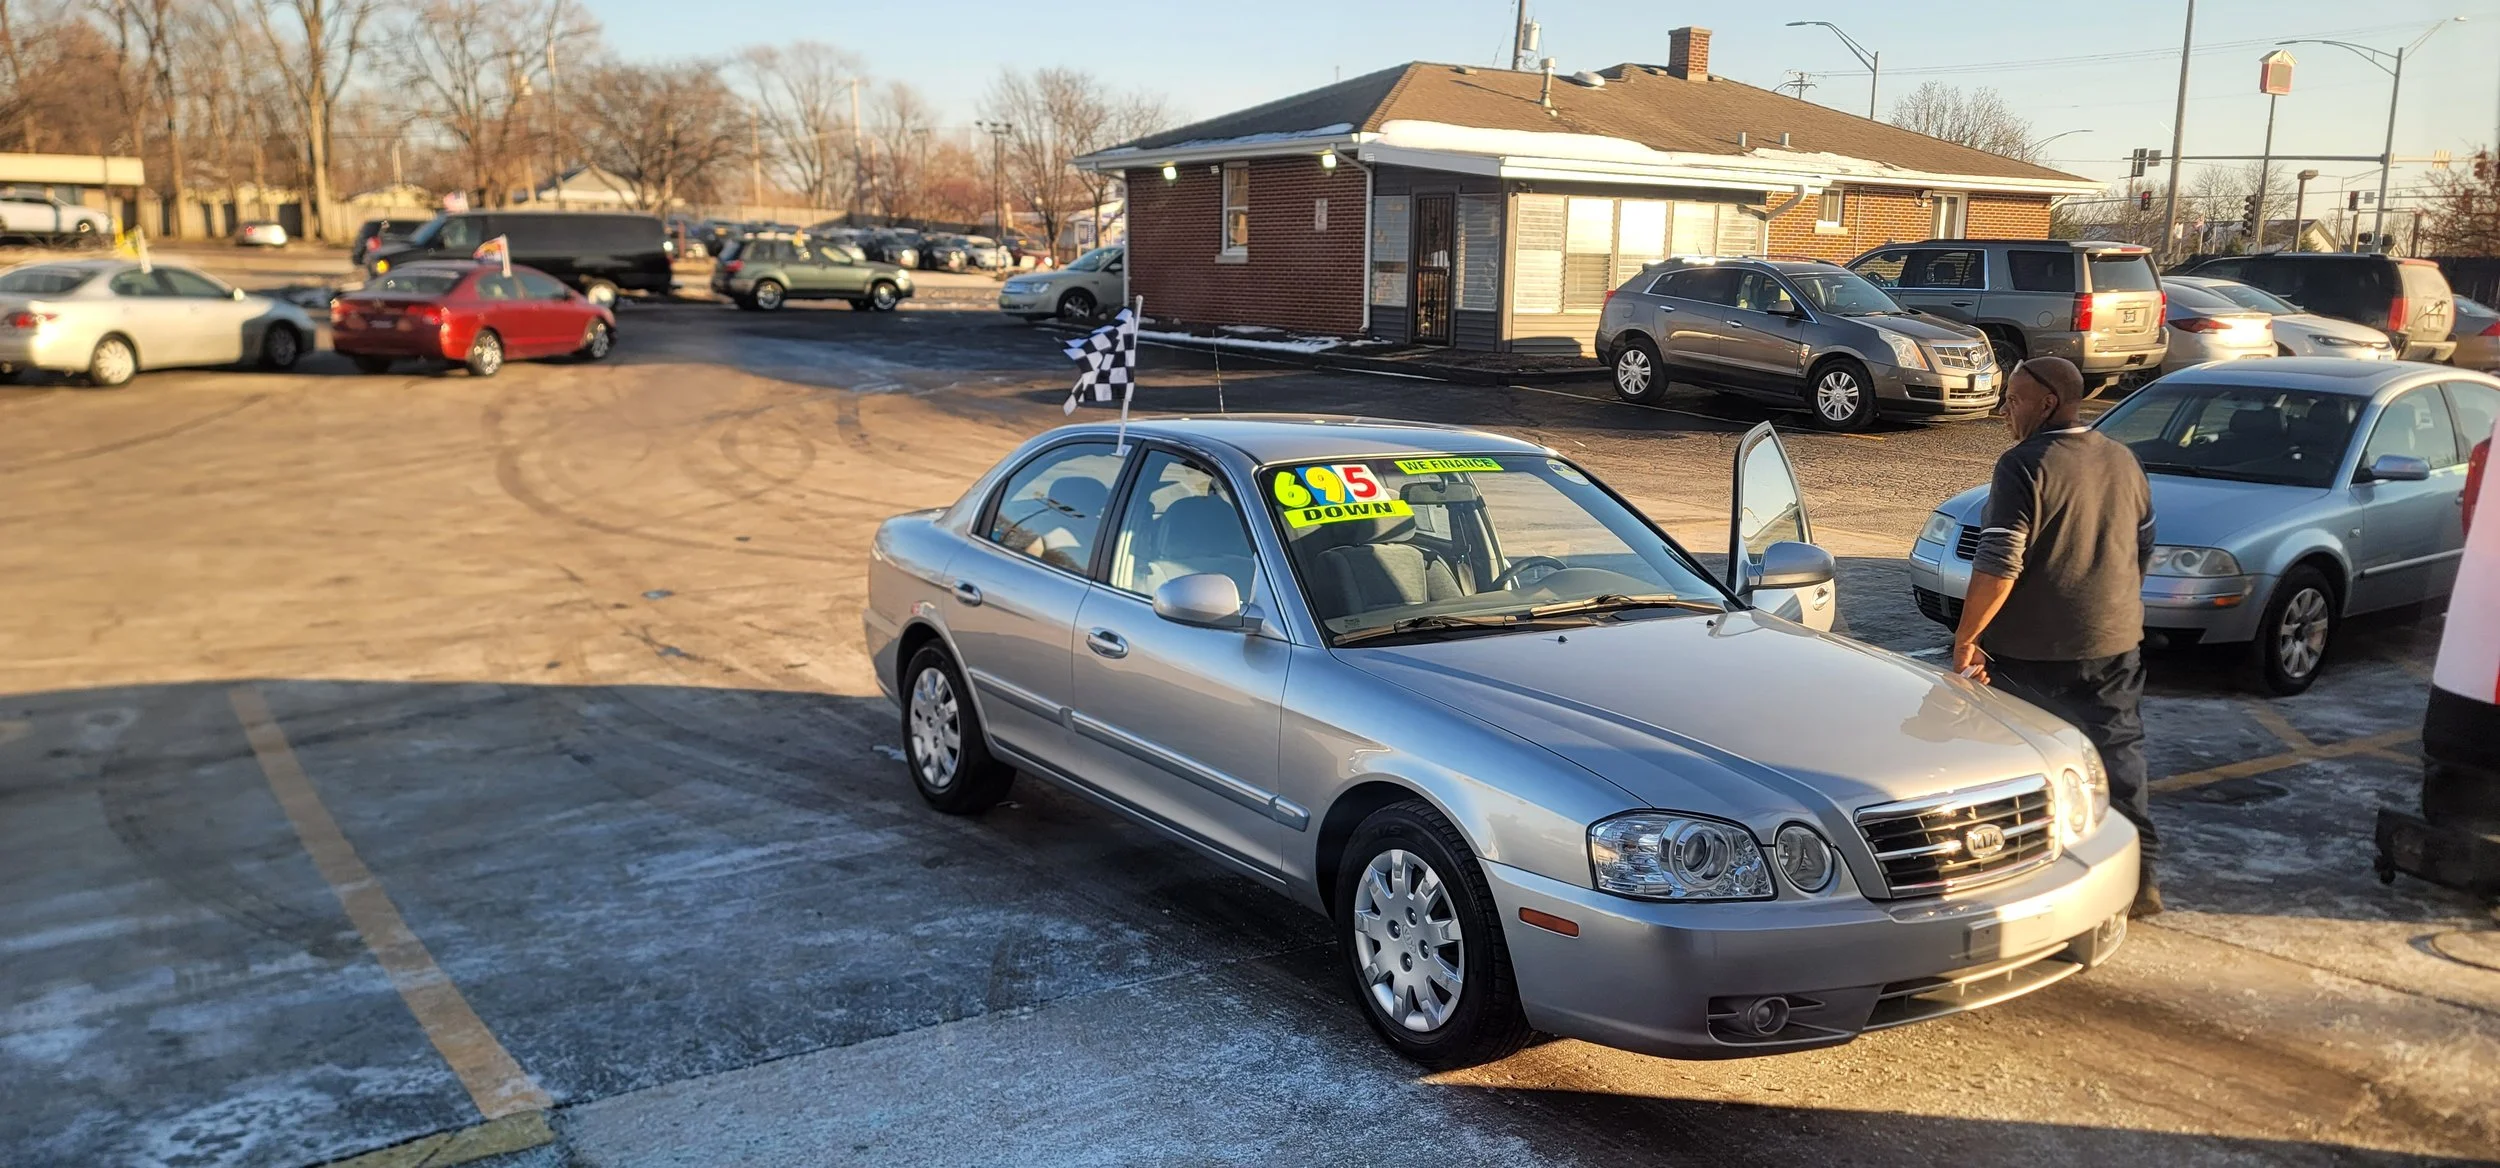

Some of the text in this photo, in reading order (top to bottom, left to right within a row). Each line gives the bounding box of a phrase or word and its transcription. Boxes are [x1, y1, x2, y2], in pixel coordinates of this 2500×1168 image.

[1403, 458, 1494, 471] WE FINANCE
[1274, 466, 1379, 508] 695
[1303, 502, 1393, 522] DOWN
